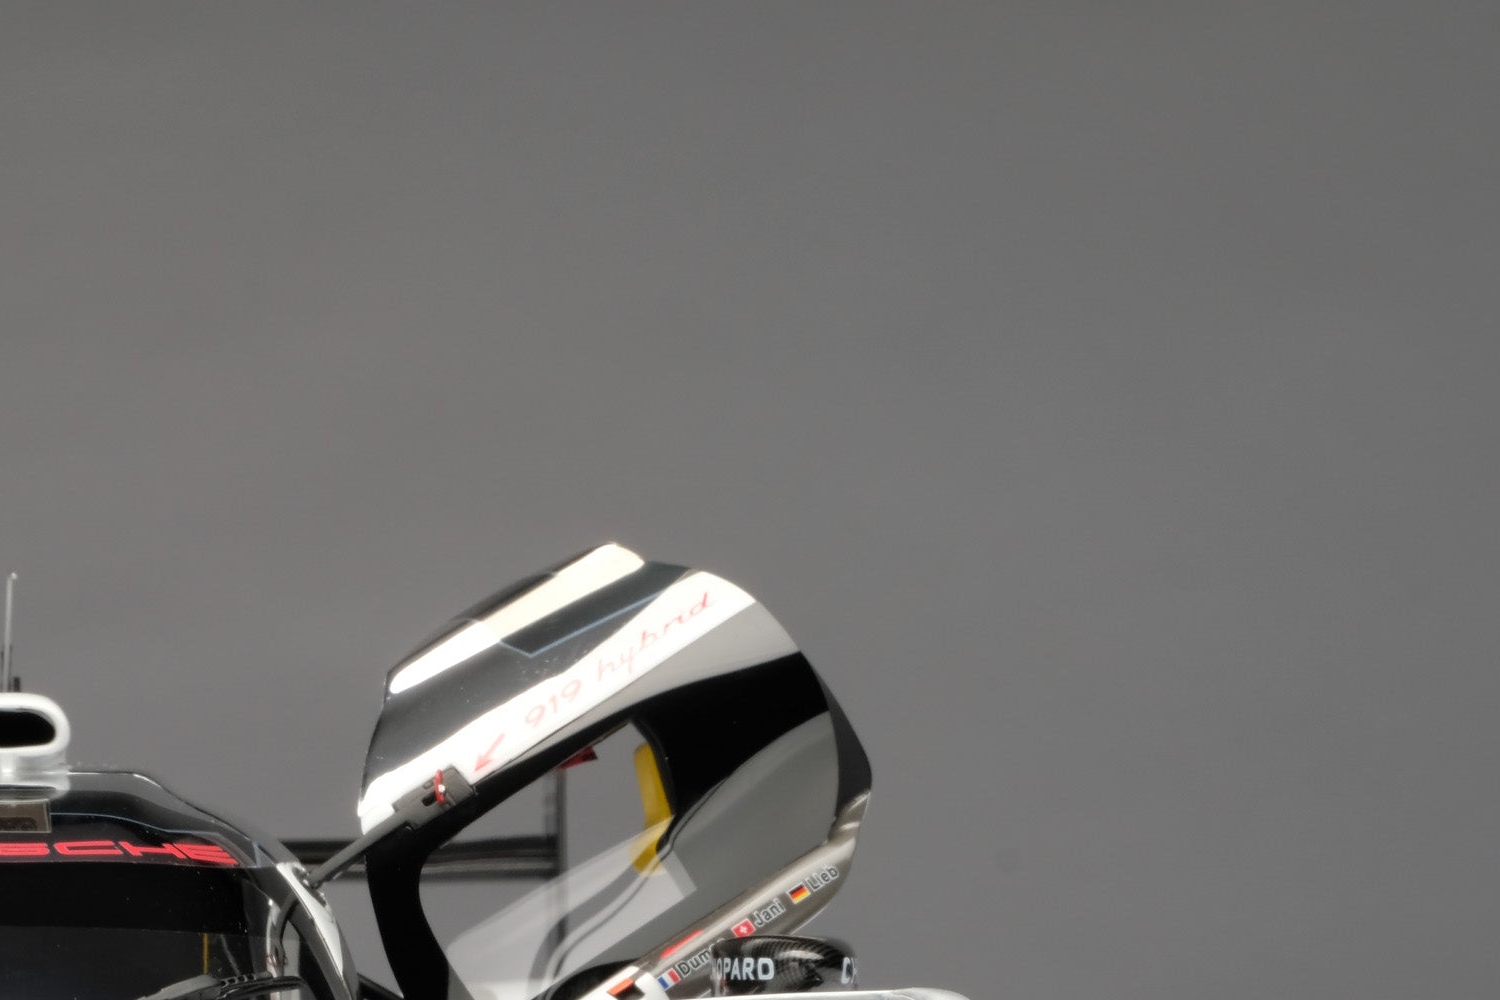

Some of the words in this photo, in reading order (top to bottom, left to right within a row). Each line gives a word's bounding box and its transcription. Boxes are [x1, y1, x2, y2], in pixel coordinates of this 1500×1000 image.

[525, 679, 582, 728] 919
[598, 592, 710, 682] hybrid
[806, 866, 839, 891] Lieb
[754, 899, 785, 926] Jani
[677, 950, 714, 977] Dum
[716, 957, 775, 981] OPARD
